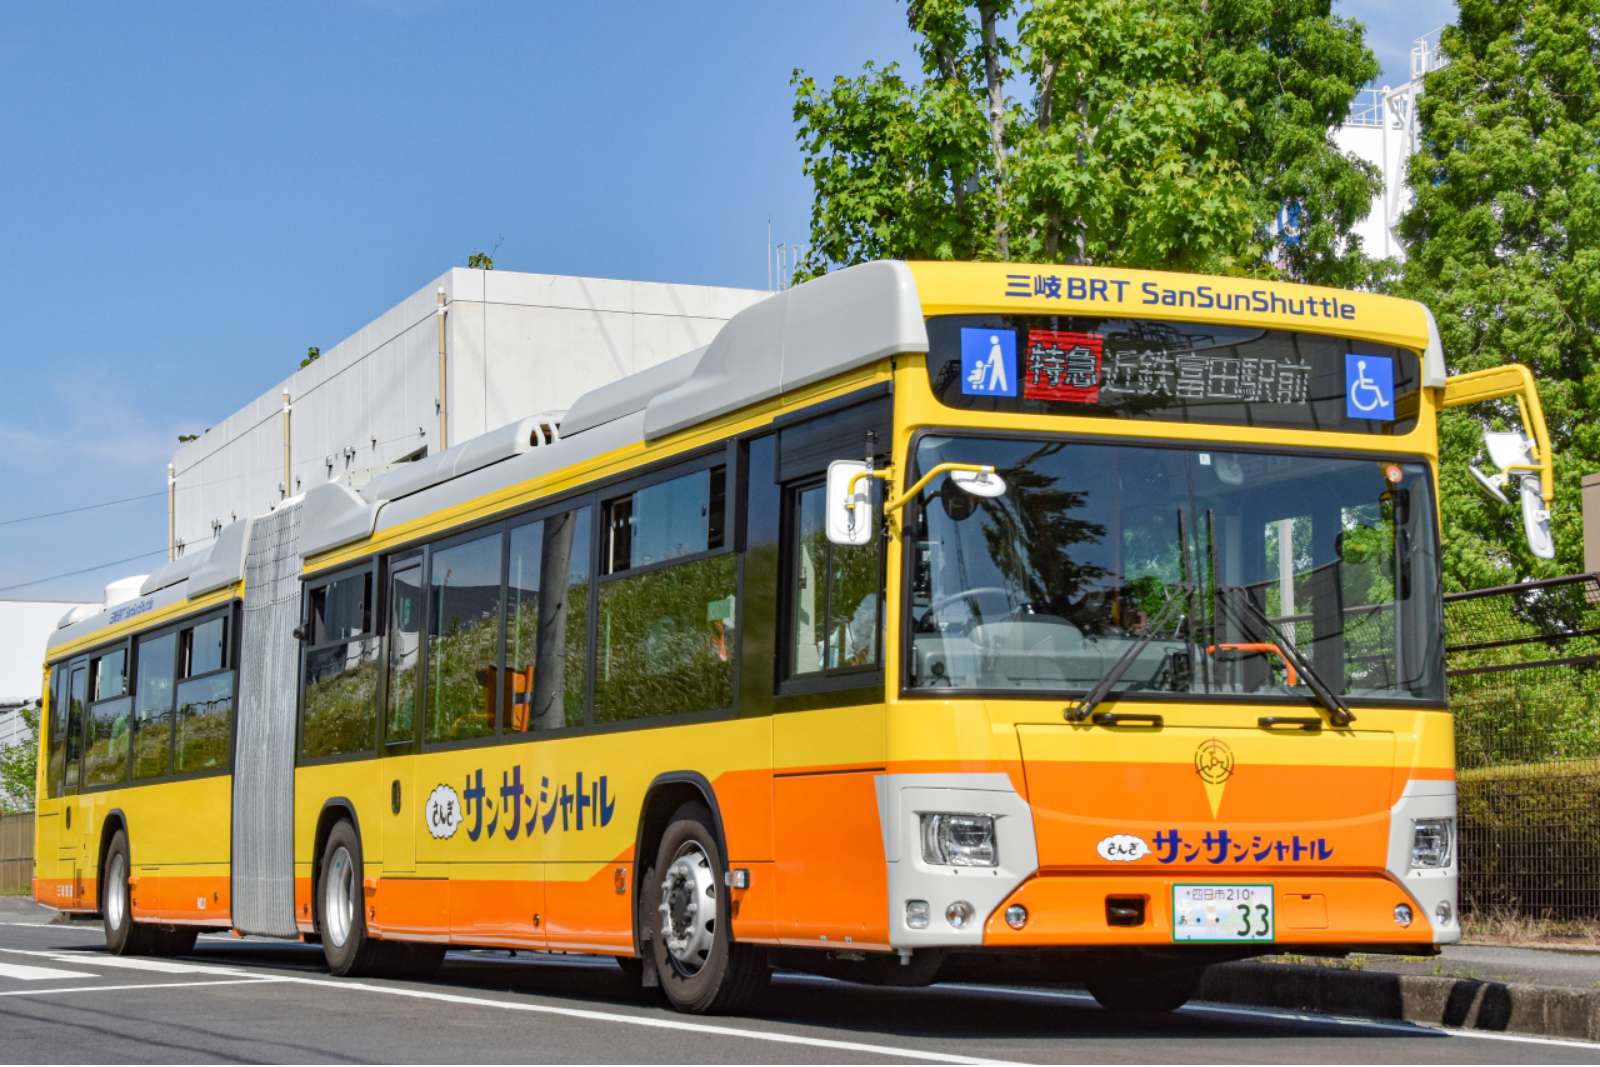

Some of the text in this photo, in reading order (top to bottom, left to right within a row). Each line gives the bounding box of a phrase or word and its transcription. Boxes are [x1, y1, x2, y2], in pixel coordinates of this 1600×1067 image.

[1142, 282, 1356, 321] SanSunShuttle
[1029, 343, 1313, 405] 特急 近鉄富田駅前
[463, 764, 616, 842] サンサンシャトル
[1152, 829, 1334, 864] サンサンシャトル
[1236, 904, 1269, 937] 33
